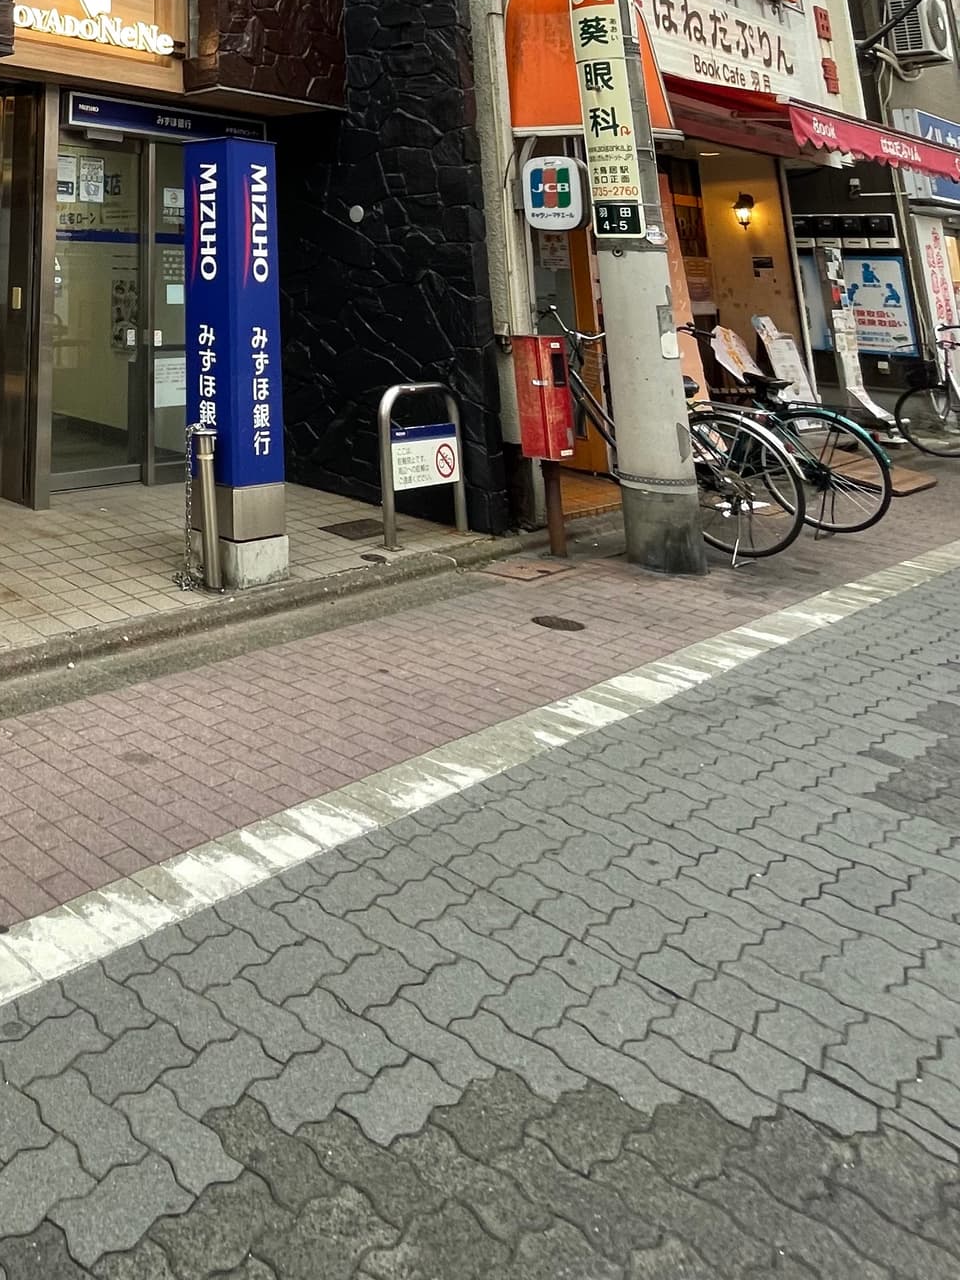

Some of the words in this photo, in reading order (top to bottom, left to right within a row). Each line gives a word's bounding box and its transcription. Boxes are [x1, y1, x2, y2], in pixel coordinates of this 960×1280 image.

[578, 16, 620, 138] 葵眼科
[693, 55, 721, 80] Book
[723, 65, 746, 87] Cafe
[200, 163, 217, 280] MIZUHO
[250, 164, 269, 283] MIZUHO
[532, 183, 569, 192] JCB
[599, 207, 632, 218] 羽田
[603, 220, 628, 230] 4-5
[198, 324, 217, 452] みずほ銀
[251, 327, 272, 456] みずほ銀行
